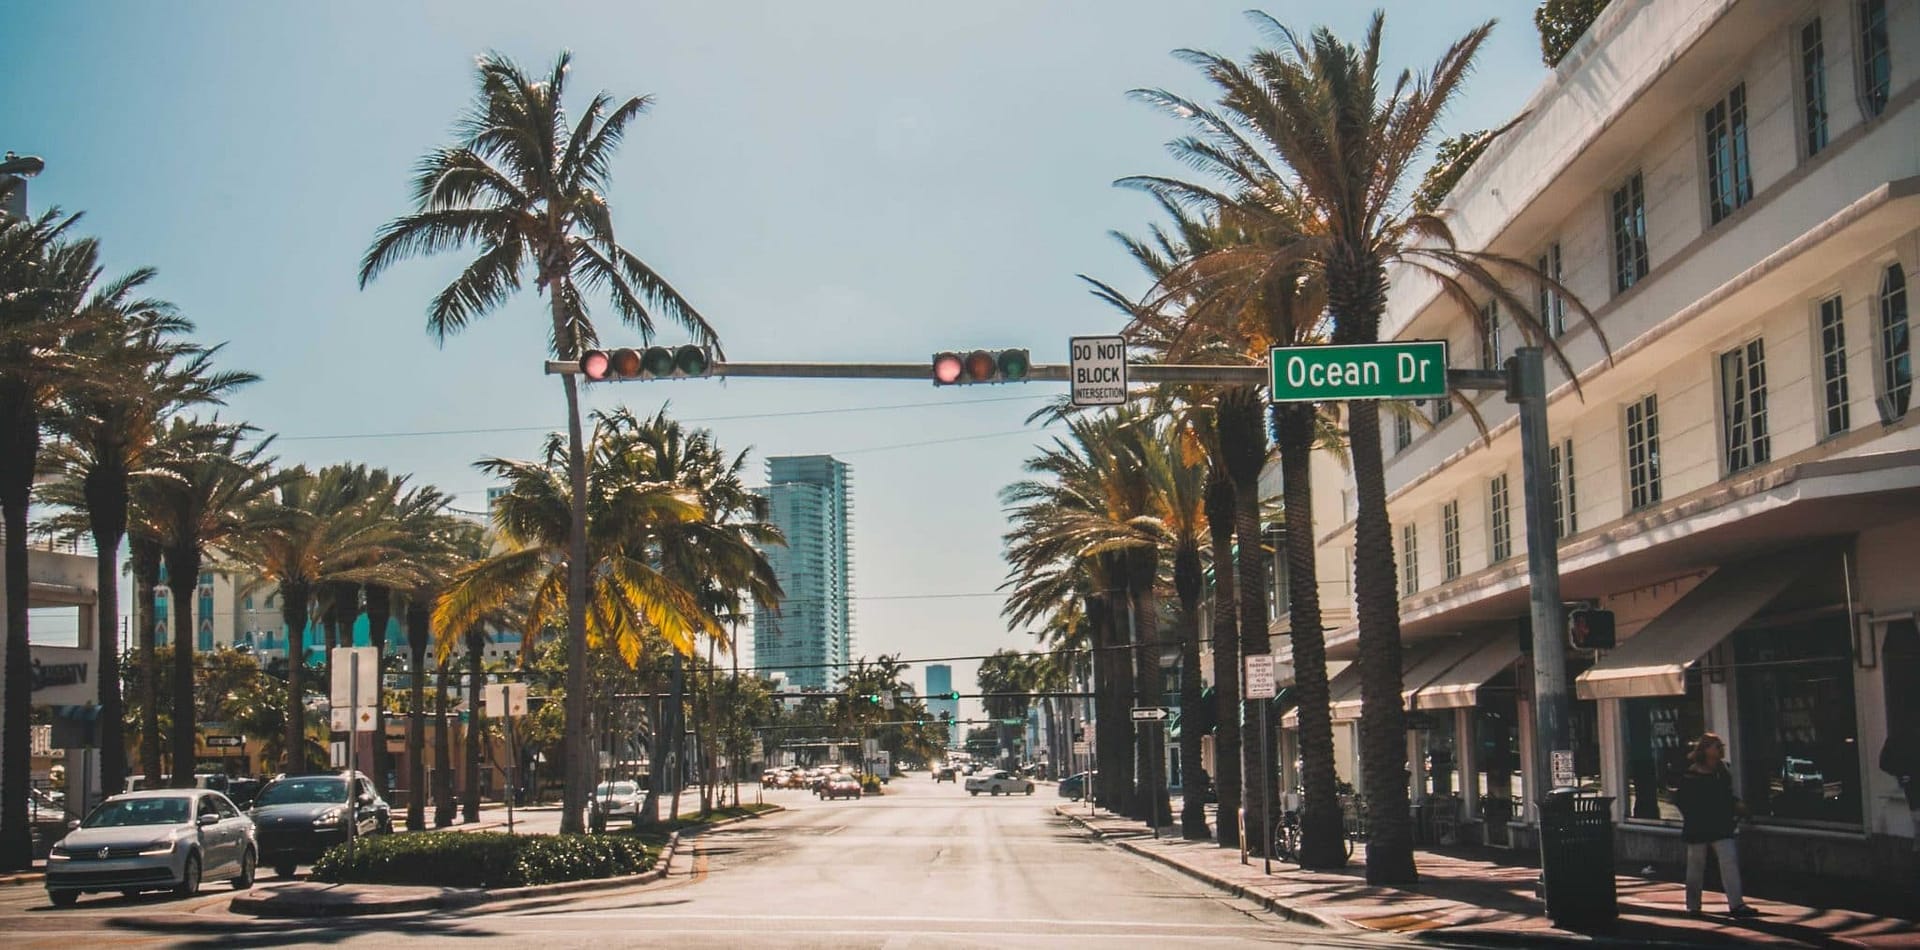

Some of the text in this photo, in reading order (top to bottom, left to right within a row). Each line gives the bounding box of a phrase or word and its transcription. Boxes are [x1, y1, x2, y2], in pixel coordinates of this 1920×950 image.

[1074, 344, 1121, 360] DO NOT
[1078, 367, 1120, 383] BLOCK
[1287, 352, 1431, 387] Ocean Dr
[1075, 387, 1124, 399] INTERSECTION
